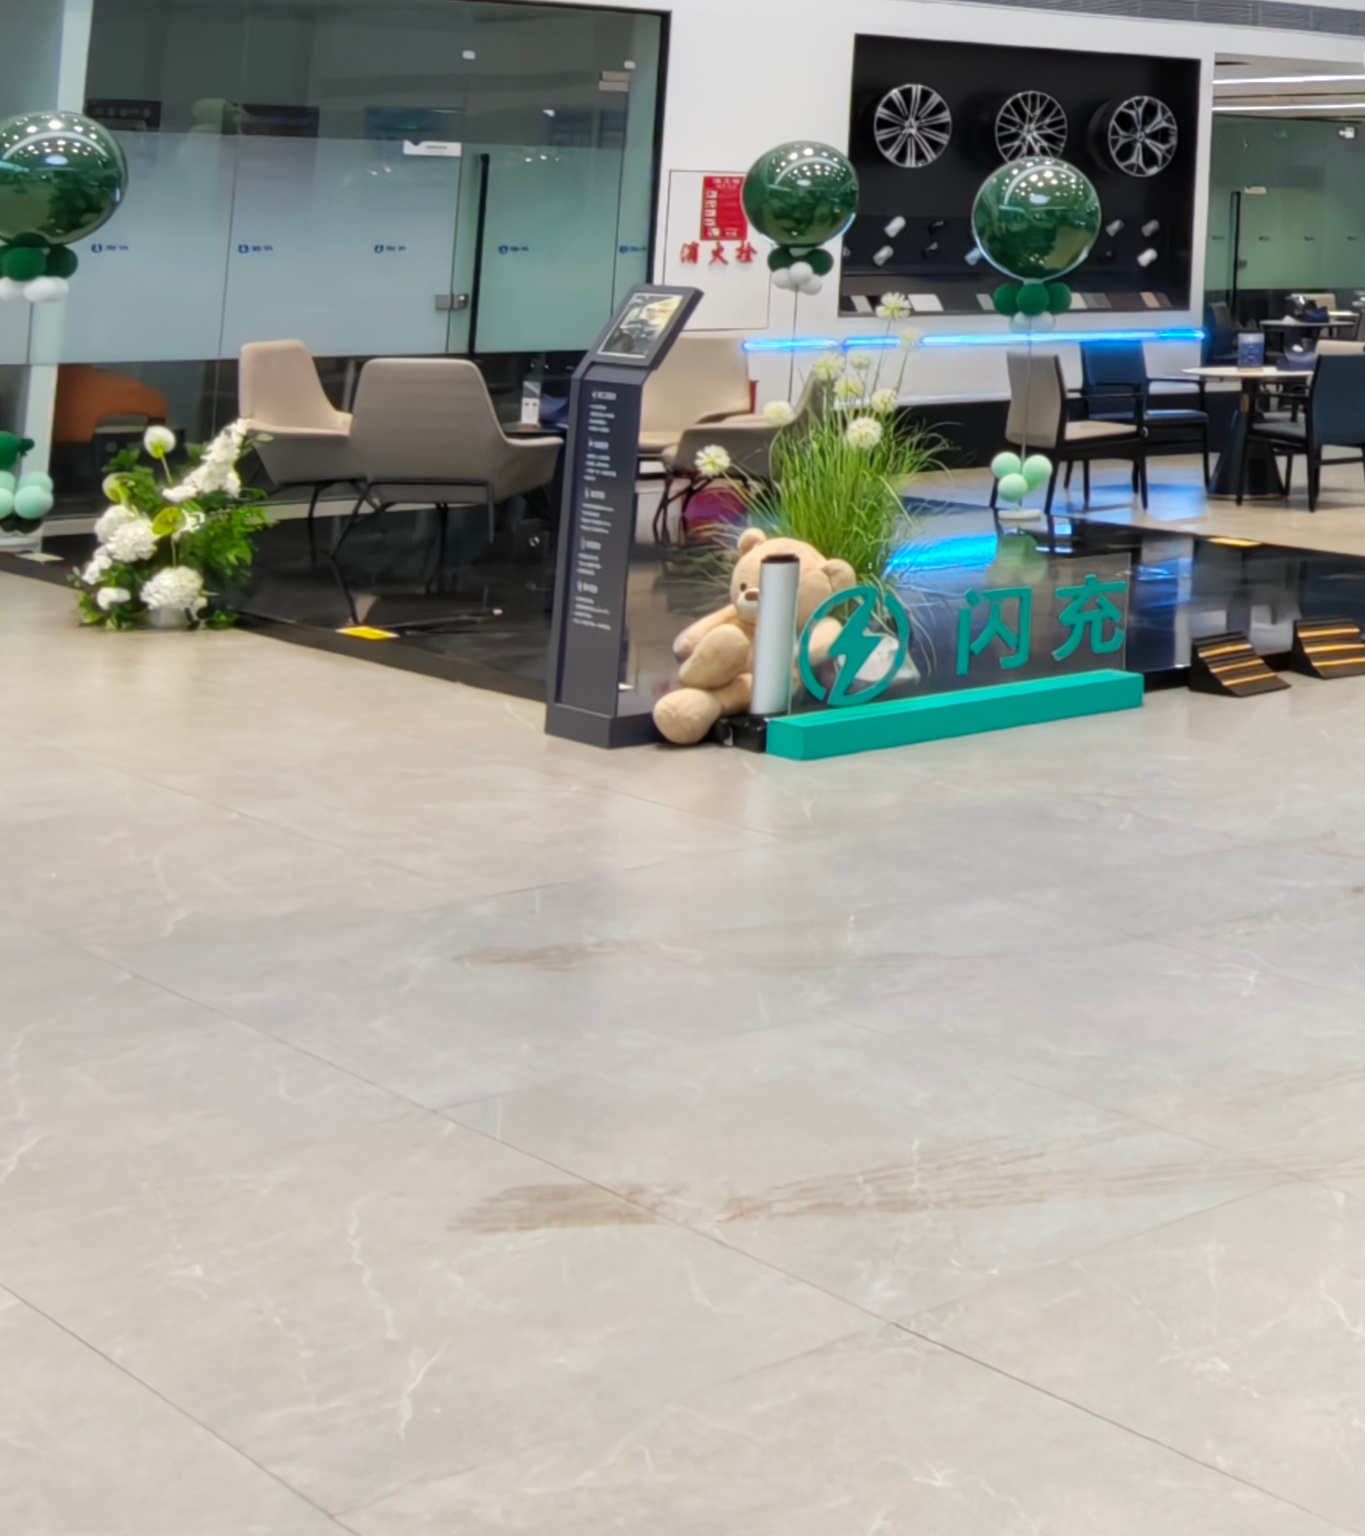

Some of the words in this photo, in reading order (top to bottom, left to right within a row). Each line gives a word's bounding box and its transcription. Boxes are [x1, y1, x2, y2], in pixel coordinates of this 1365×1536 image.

[680, 241, 758, 265] 消火栓
[956, 573, 1128, 677] 闪充
